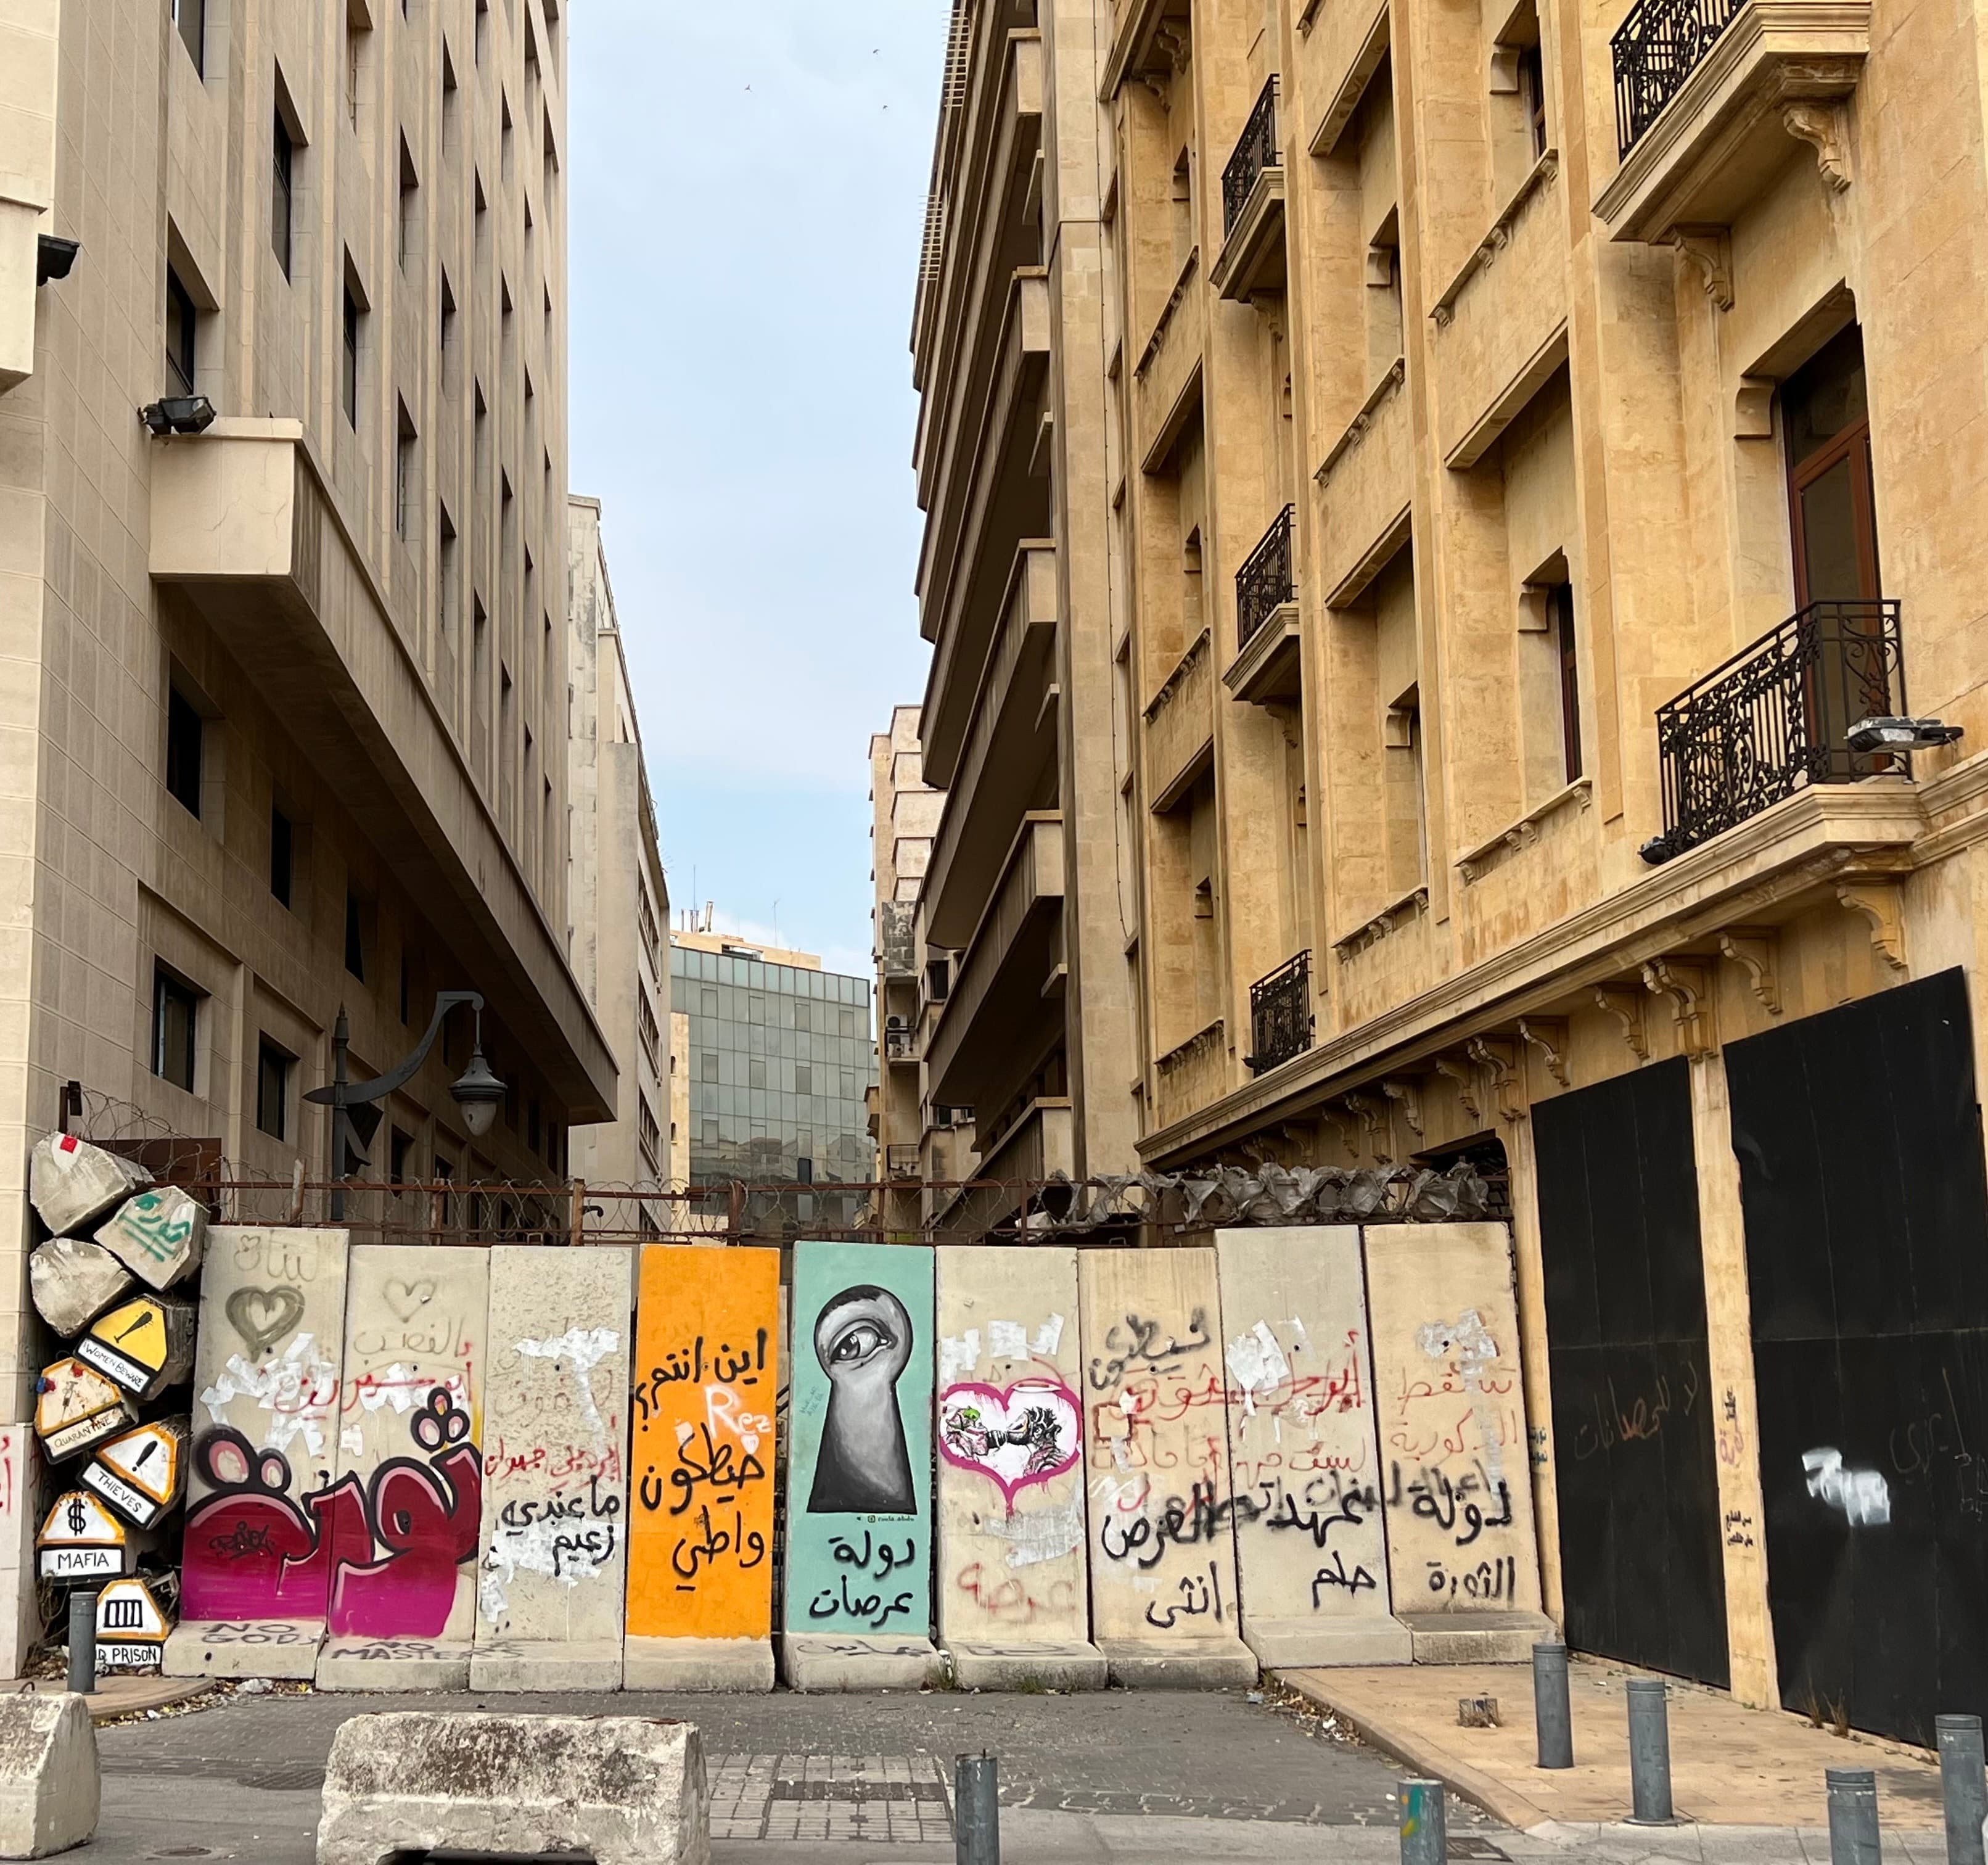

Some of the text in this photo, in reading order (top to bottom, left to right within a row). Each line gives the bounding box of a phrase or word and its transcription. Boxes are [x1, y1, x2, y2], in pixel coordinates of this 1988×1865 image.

[86, 1343, 144, 1388] WOMEN BEWARE
[714, 1328, 767, 1386] اين
[98, 1470, 142, 1513] THIEVES
[57, 1552, 110, 1570] MAFIA
[828, 1529, 916, 1581] دولة
[205, 1623, 297, 1634] NO
[112, 1645, 158, 1664] PRISON
[331, 1647, 524, 1660] MASTERS
